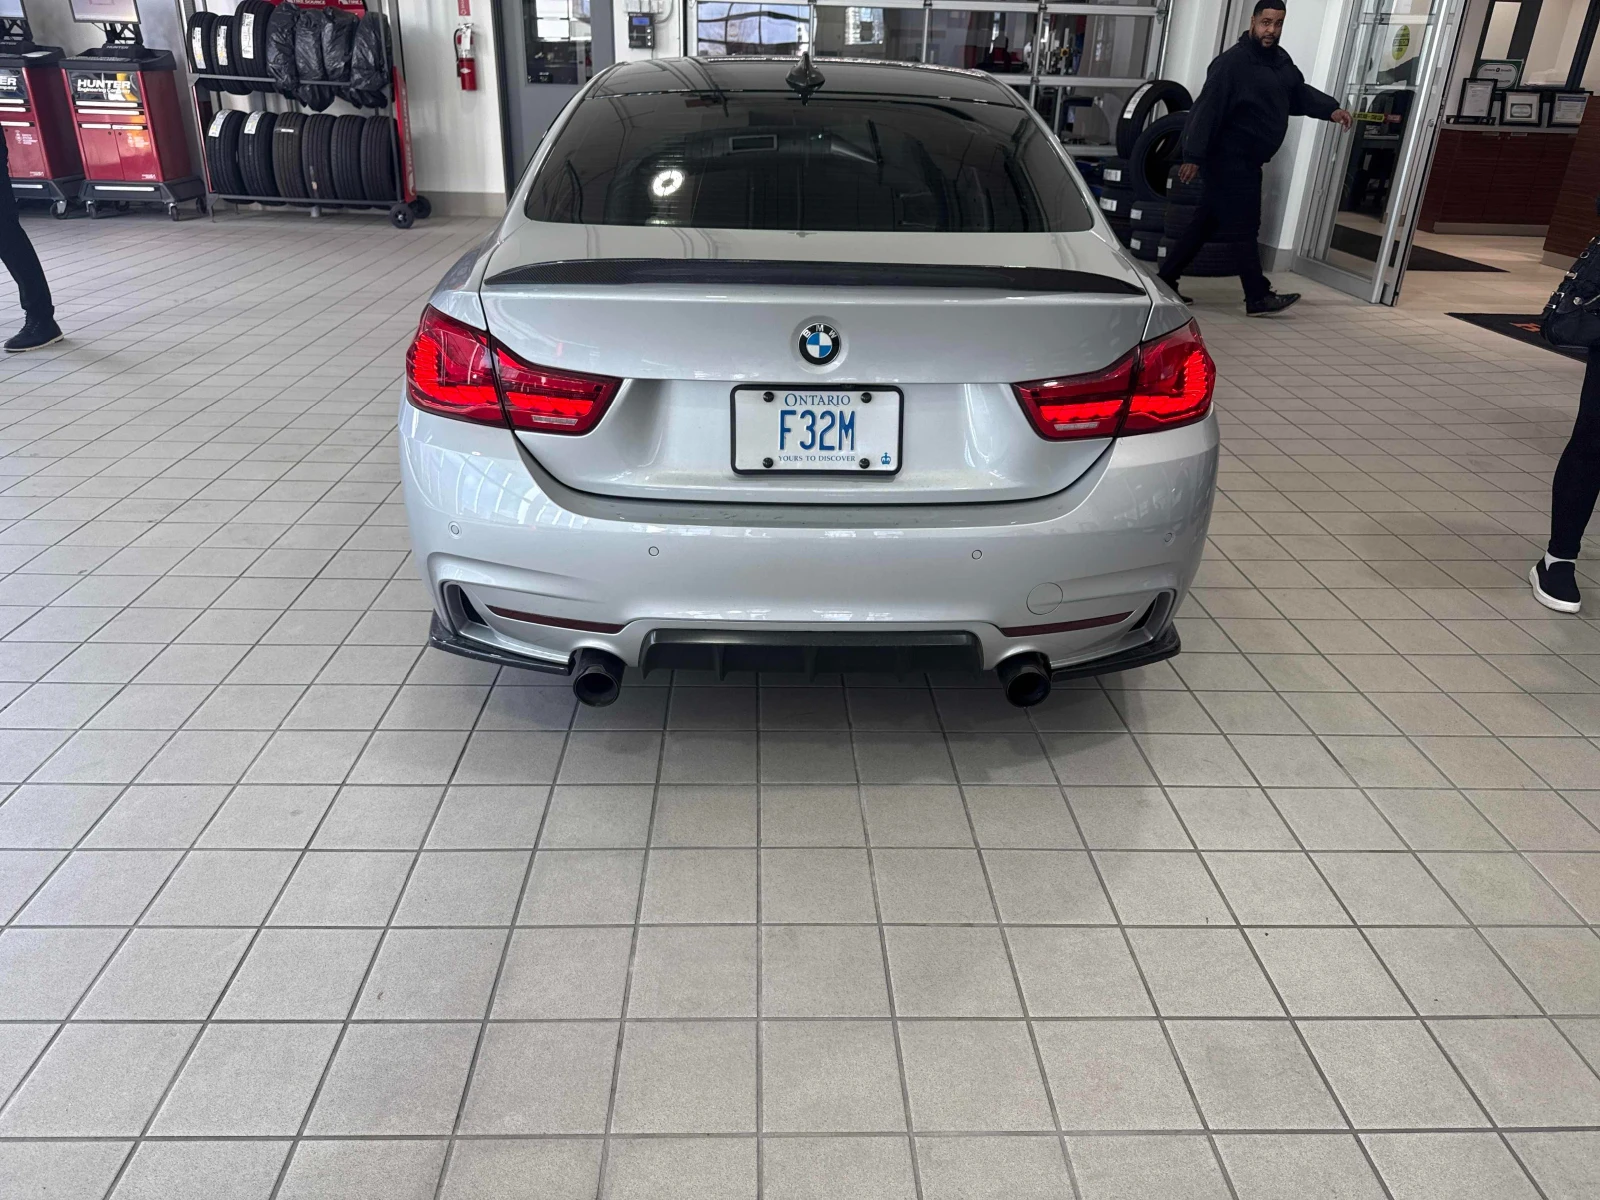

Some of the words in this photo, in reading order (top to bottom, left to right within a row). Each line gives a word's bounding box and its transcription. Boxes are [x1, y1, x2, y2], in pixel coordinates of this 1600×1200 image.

[77, 78, 131, 88] HUNTER
[802, 324, 838, 339] BMW
[779, 409, 856, 451] F32M
